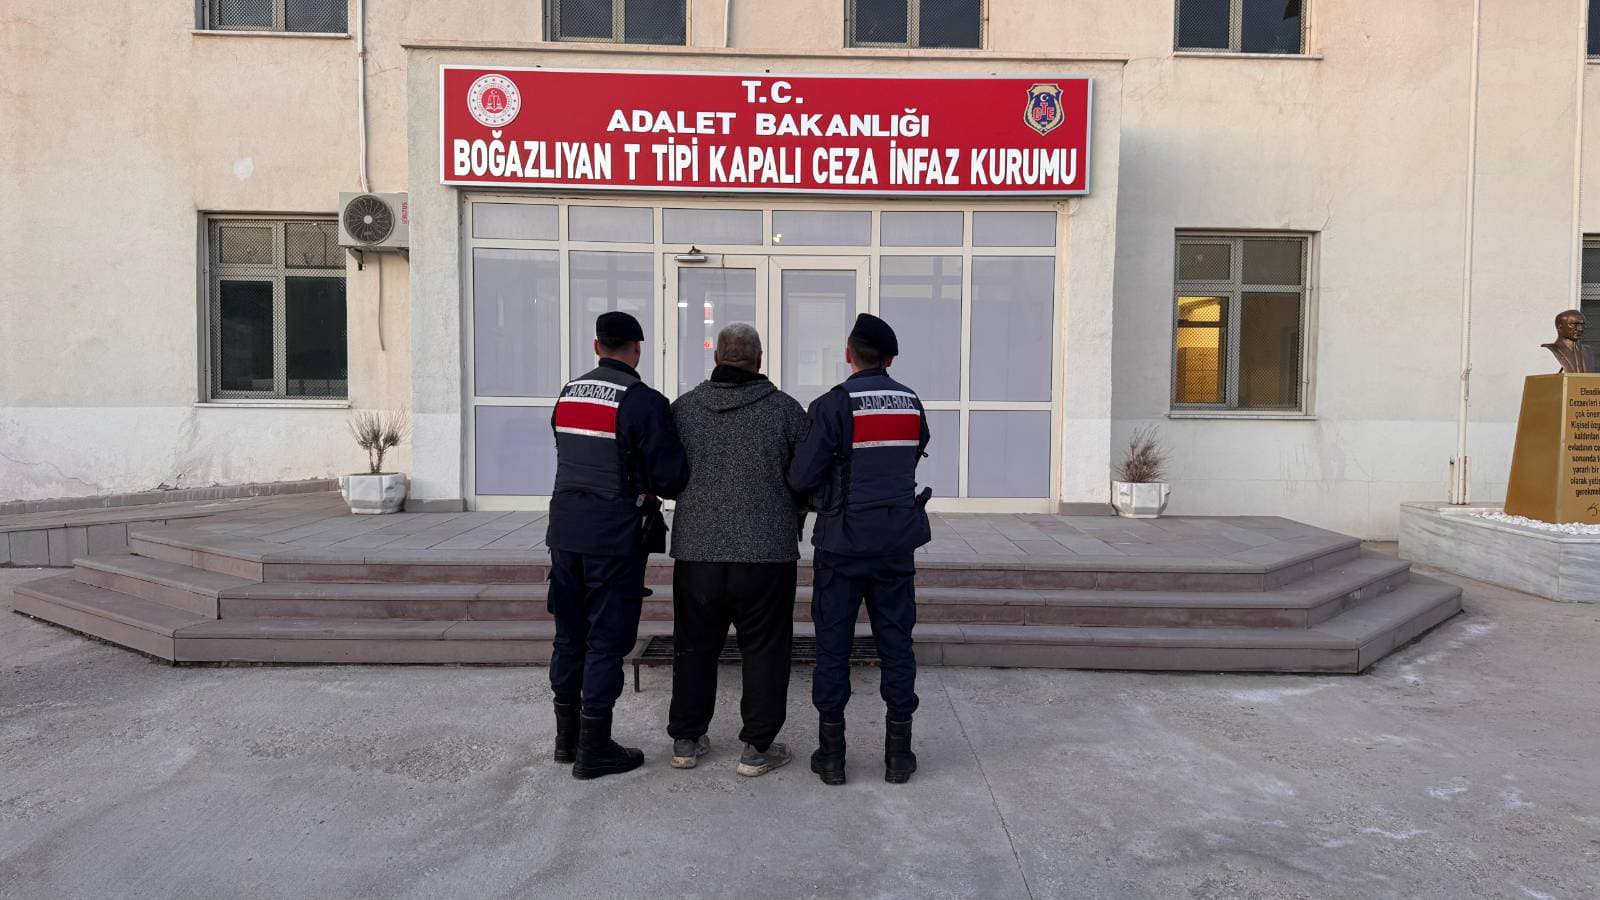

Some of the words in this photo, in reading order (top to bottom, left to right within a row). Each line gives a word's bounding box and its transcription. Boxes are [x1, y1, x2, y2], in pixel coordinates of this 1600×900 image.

[741, 80, 803, 104] T.C.
[607, 109, 736, 134] ADALET
[755, 107, 929, 138] BAKANLIĞI
[453, 130, 612, 180] BOĞAZLIYAN
[624, 143, 640, 180] T
[652, 136, 699, 181] TİPİ
[709, 145, 801, 183] KAPALI
[812, 147, 878, 185] CEZA
[889, 140, 960, 185] İNFAZ
[971, 148, 1077, 185] KURUMU
[565, 384, 617, 401] JANDARMA
[859, 394, 915, 410] JANDARMA
